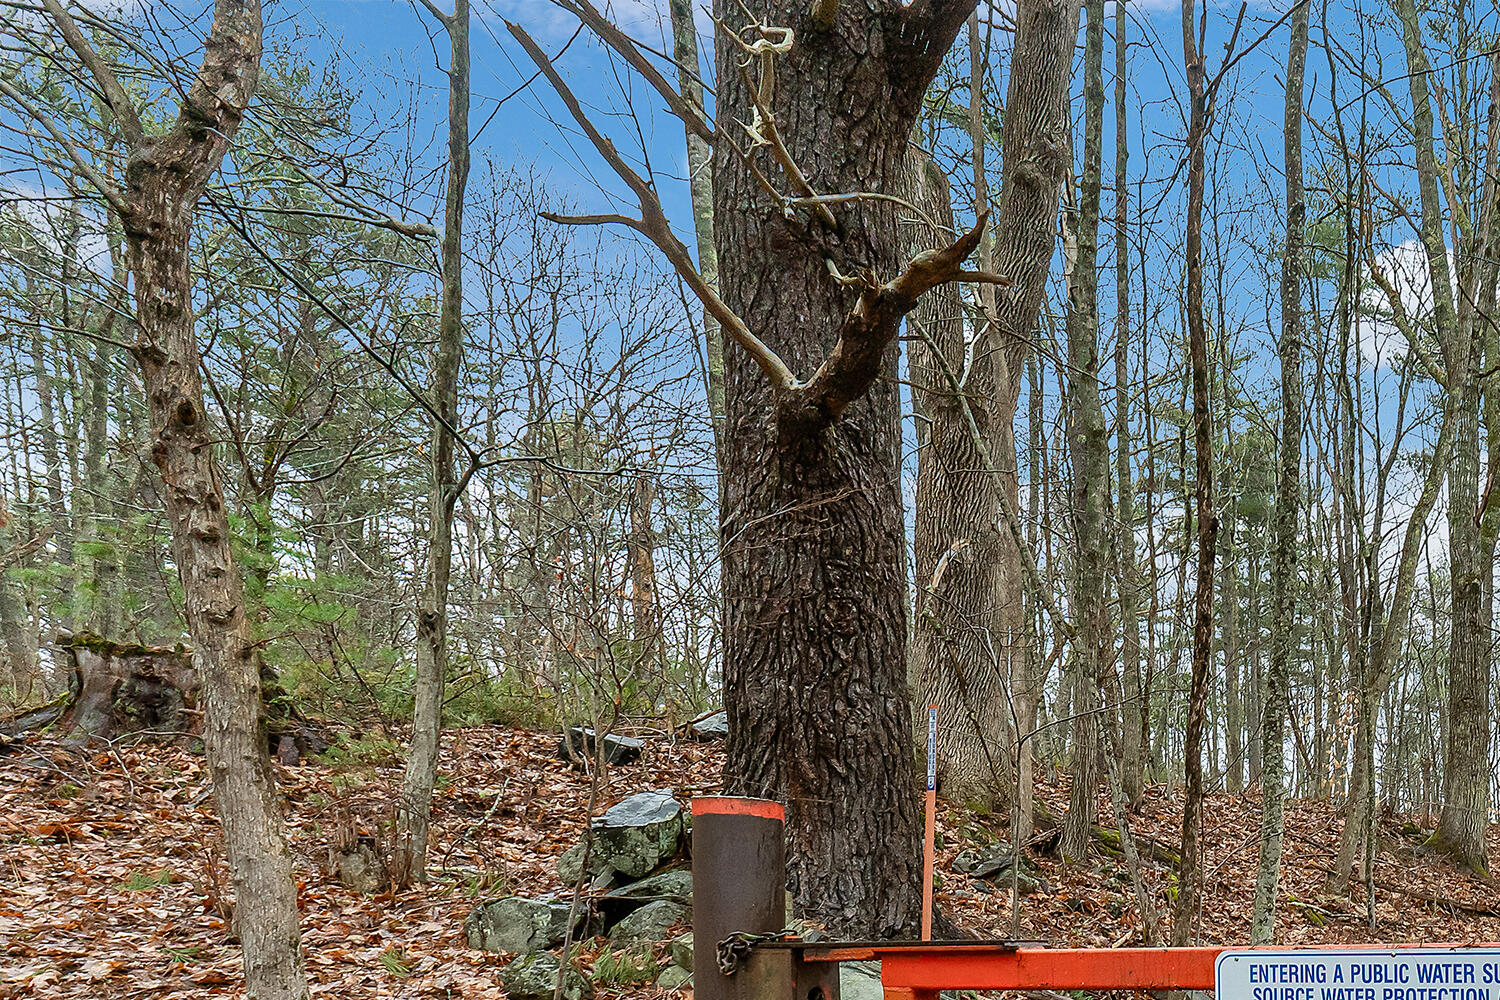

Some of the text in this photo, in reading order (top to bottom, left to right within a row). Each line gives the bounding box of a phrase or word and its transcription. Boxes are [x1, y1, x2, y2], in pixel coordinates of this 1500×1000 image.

[1250, 964, 1326, 983] ENTERING
[1333, 964, 1344, 983] A
[1351, 964, 1409, 983] PUBLIC
[1417, 964, 1475, 983] WATER
